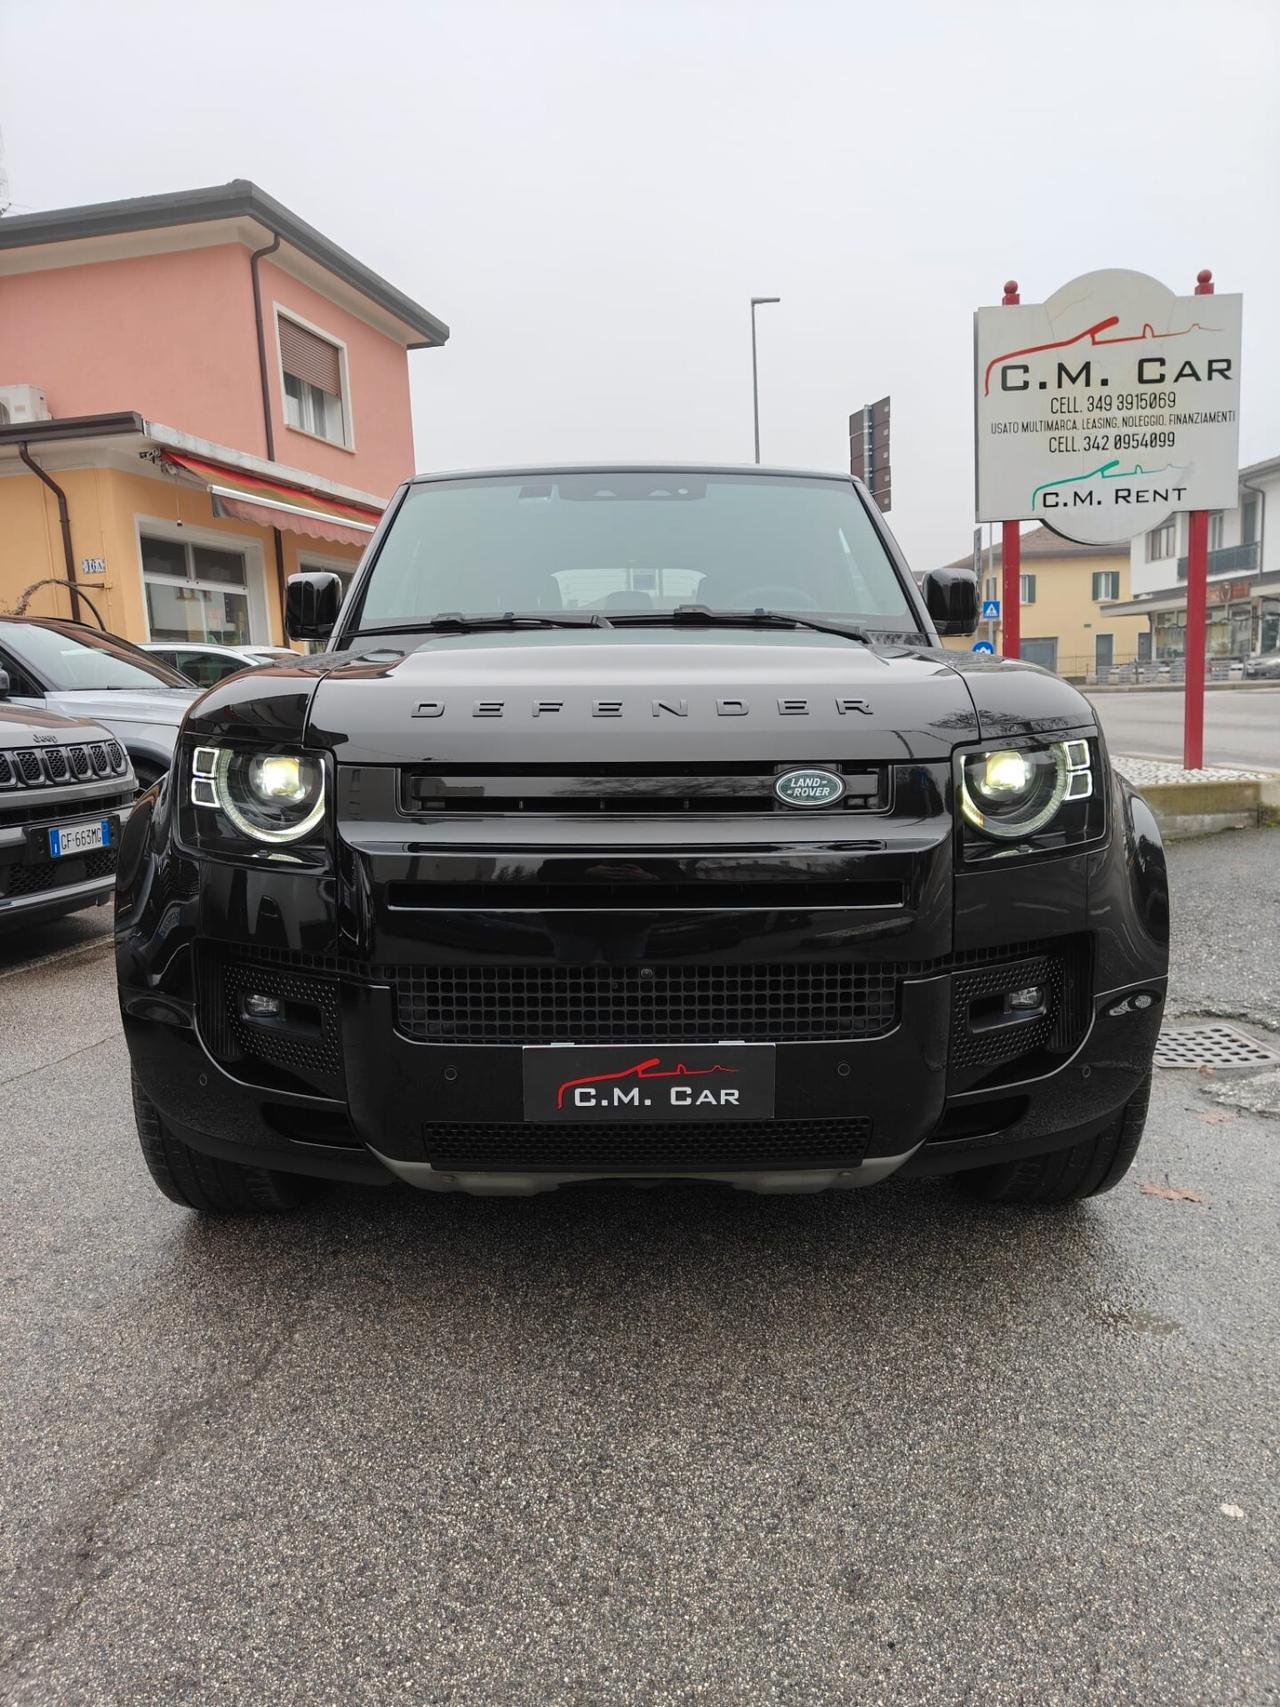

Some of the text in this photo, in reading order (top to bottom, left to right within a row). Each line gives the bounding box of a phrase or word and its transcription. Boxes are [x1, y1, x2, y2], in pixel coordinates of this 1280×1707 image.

[1001, 357, 1233, 391] C.M. CAR
[1050, 392, 1176, 414] CELL. 349 3915069
[991, 422, 1019, 435] USATO
[1169, 410, 1236, 425] FINANZIAMENTI
[1049, 432, 1176, 453] CELL. 342 0954099
[1042, 488, 1187, 508] C.M. RENT
[411, 698, 874, 718] DEFENDER
[574, 1086, 740, 1107] C.M. CAR
